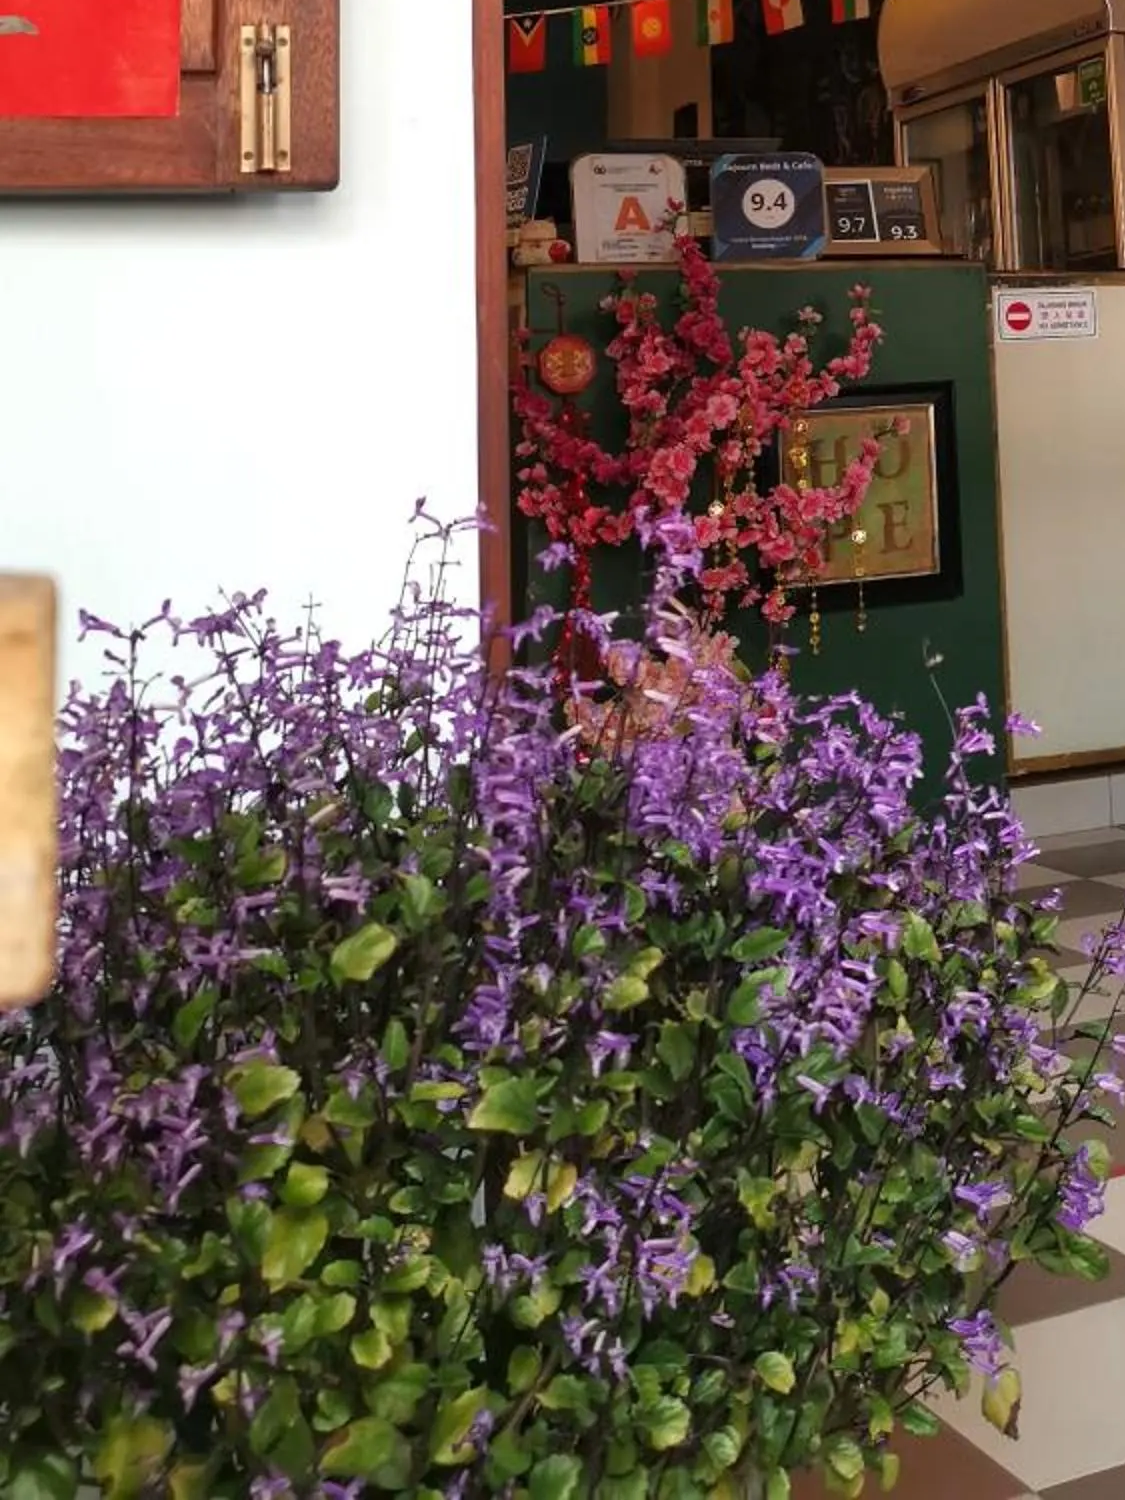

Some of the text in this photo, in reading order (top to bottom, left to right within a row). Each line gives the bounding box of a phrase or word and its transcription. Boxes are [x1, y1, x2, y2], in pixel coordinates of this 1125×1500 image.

[751, 193, 788, 211] 9.4
[614, 196, 651, 231] A
[837, 217, 865, 234] 9.7
[891, 225, 919, 240] 9.3
